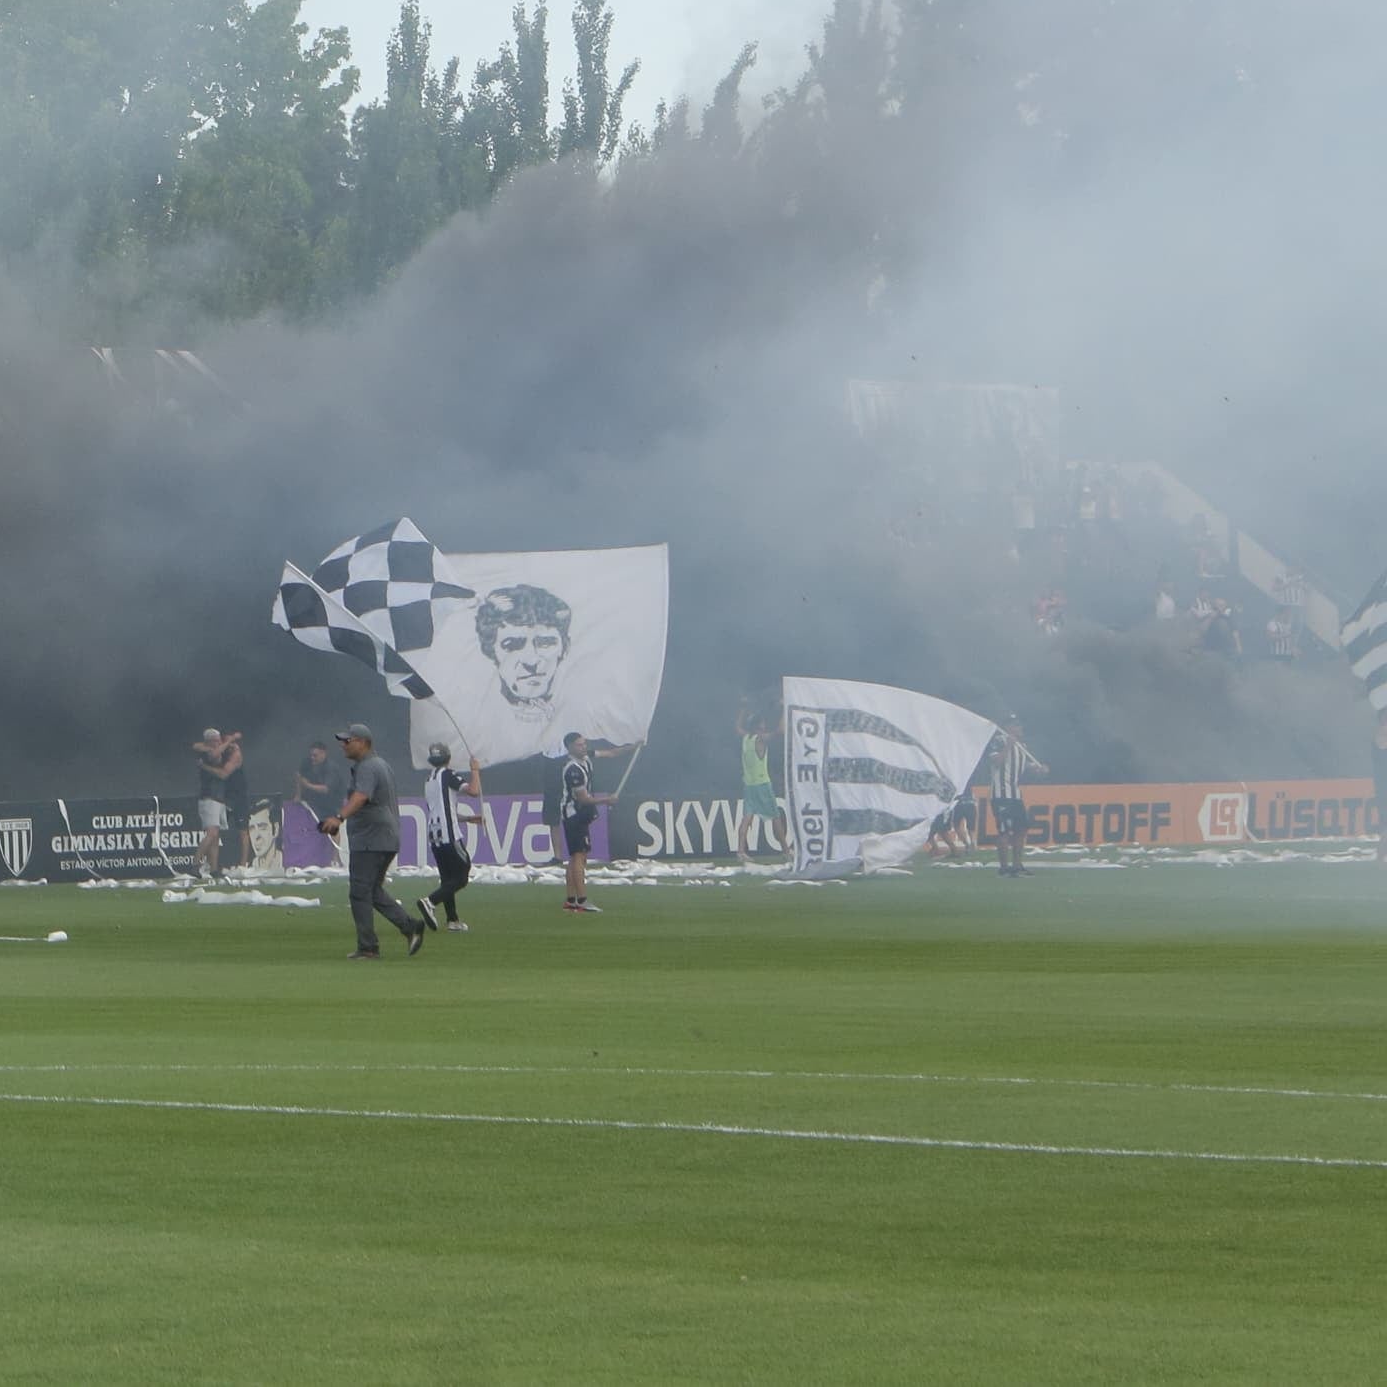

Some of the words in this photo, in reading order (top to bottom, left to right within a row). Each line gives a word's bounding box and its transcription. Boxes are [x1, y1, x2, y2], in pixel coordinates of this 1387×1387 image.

[92, 815, 123, 829] CLUB
[126, 811, 183, 829] ATLÉTICO
[977, 797, 1171, 845] LSQTOFF
[51, 832, 134, 853] GIMNASIA
[135, 832, 147, 850] Y
[96, 857, 125, 869] VÍCTOR
[127, 856, 162, 867] ANTONIO
